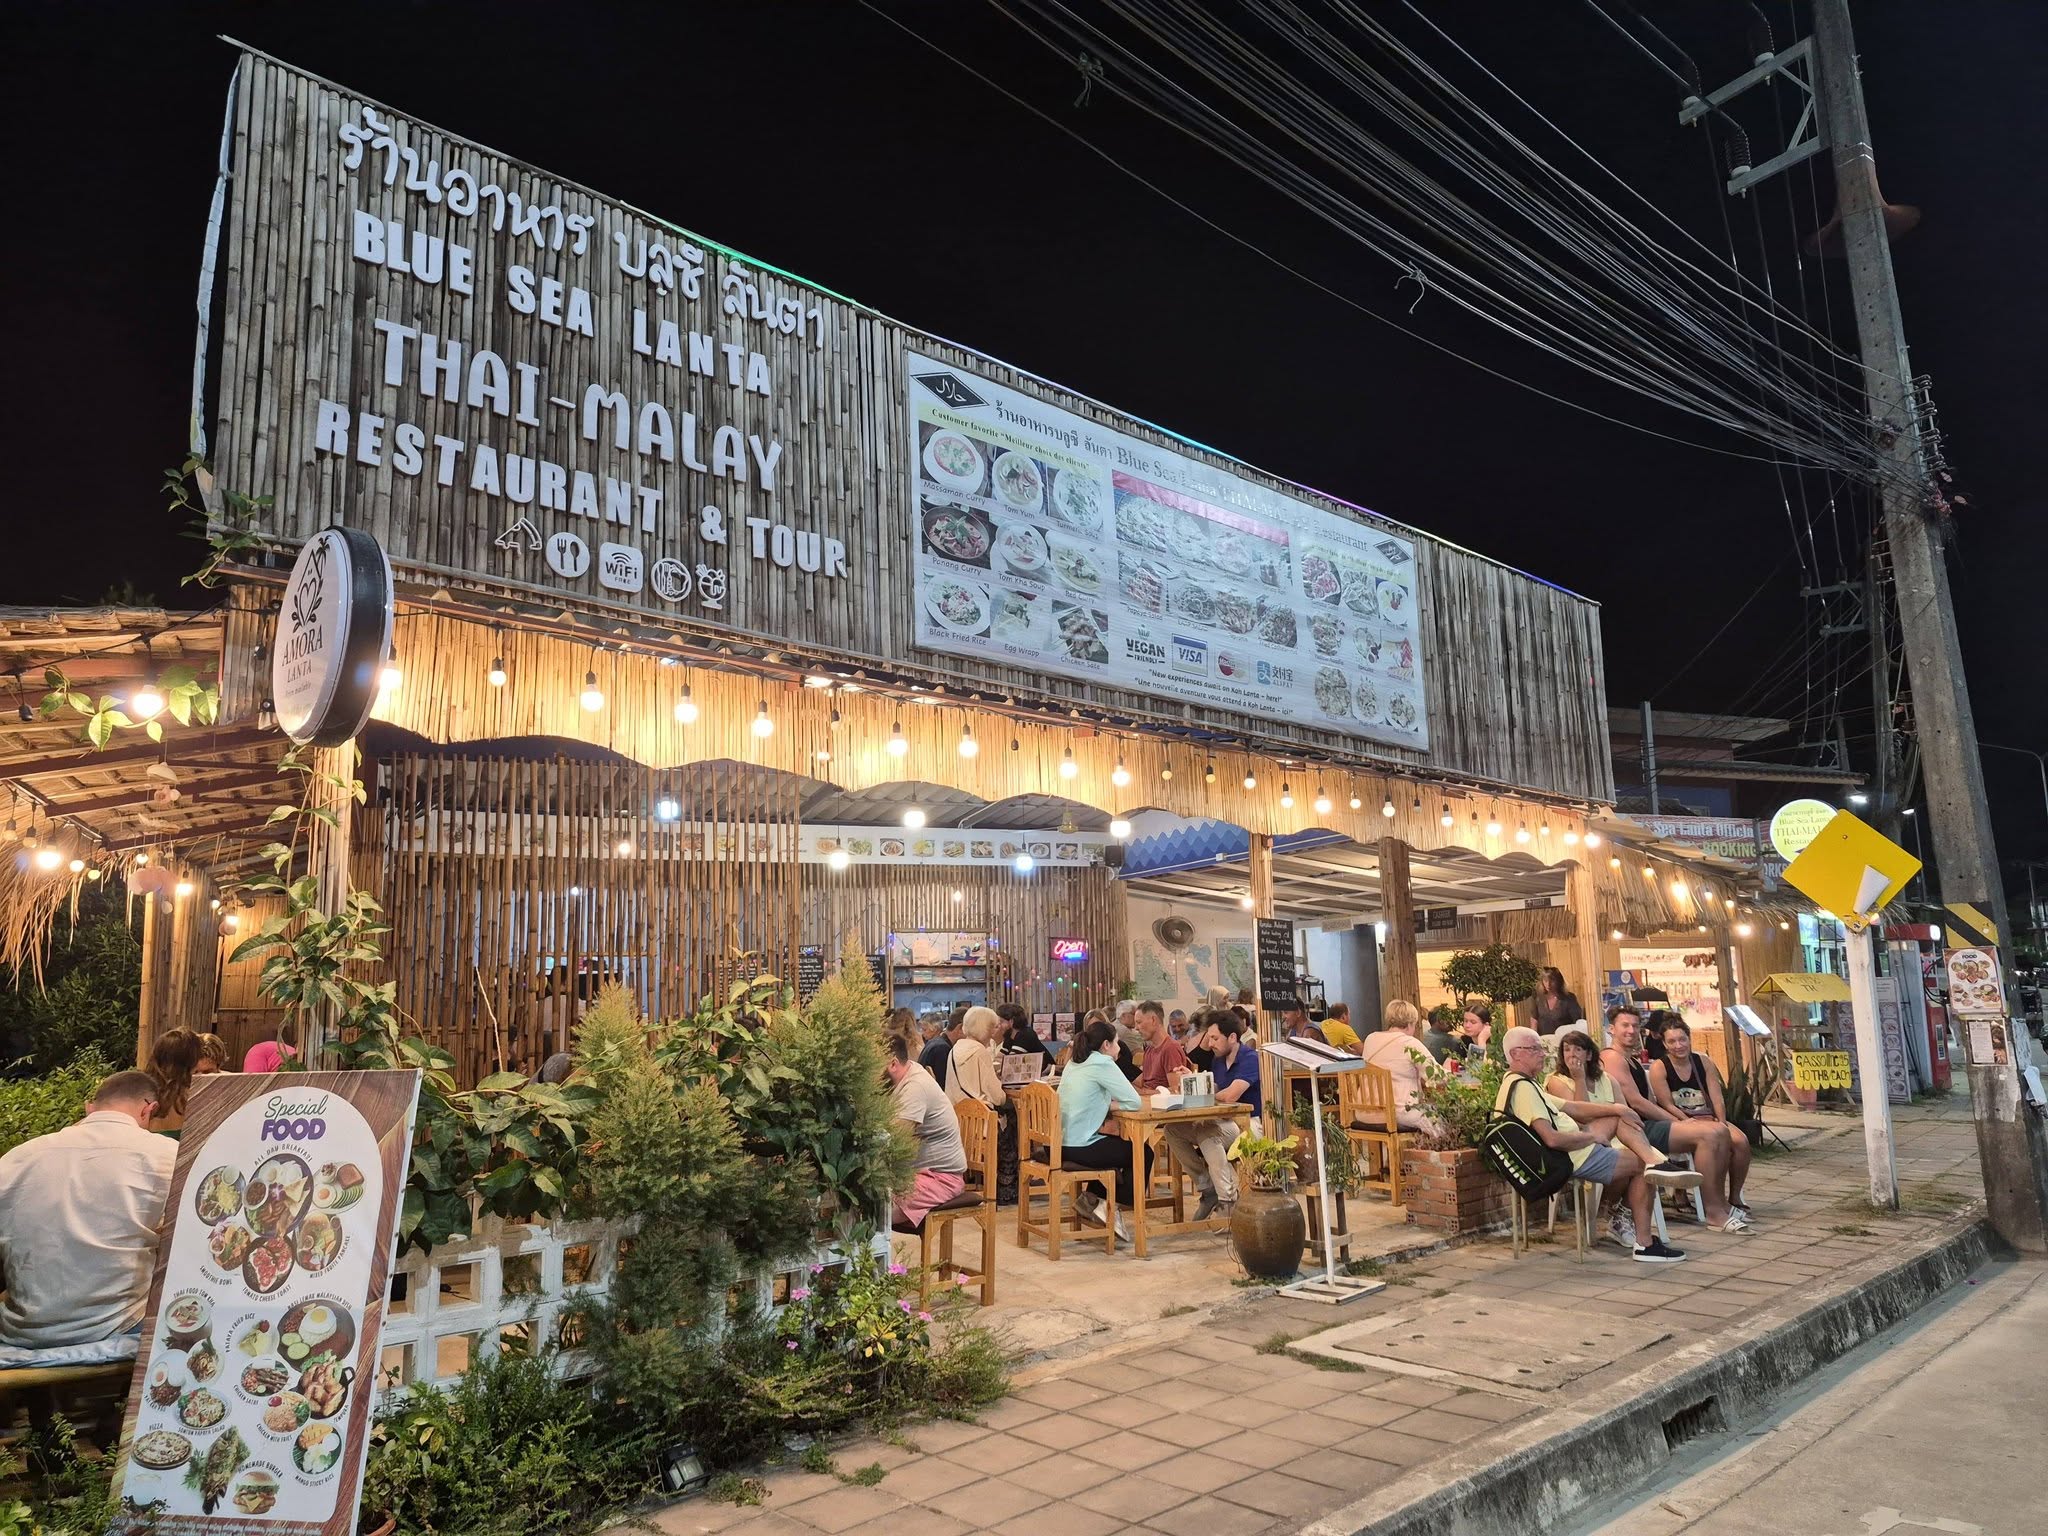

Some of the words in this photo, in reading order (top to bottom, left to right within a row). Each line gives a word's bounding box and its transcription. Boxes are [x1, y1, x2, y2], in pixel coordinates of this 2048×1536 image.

[339, 106, 595, 255] ร้านอาหาร
[724, 261, 824, 350] ลันตา
[354, 210, 474, 299] BLUE
[508, 265, 594, 339] SEA
[633, 308, 772, 397] LANTA
[375, 318, 783, 492] THAI-MALAY
[932, 408, 969, 428] Customer
[971, 421, 998, 439] favorite
[1118, 446, 1149, 473] Blue
[315, 400, 664, 533] RESTAURANT
[699, 505, 728, 546] &
[747, 516, 849, 579] TOUR
[923, 481, 964, 498] Massaman
[966, 493, 986, 505] Curry
[1004, 504, 1019, 514] Tom
[1021, 508, 1035, 519] Yum
[606, 561, 638, 579] WiFi
[932, 557, 959, 571] Panang
[961, 564, 981, 576] Curry
[999, 573, 1013, 583] Tom
[282, 625, 322, 666] AMORA
[929, 628, 950, 639] Black
[952, 633, 970, 643] Fried
[971, 637, 987, 646] Rice
[1126, 638, 1165, 658] VEGAN
[1004, 643, 1017, 655] Egg
[1018, 645, 1040, 658] Wrapp
[1179, 647, 1202, 664] VISA
[288, 659, 312, 683] LANTA
[1168, 674, 1202, 687] experiences
[1243, 690, 1260, 699] Lanta
[1180, 688, 1206, 698] aventure
[1248, 701, 1259, 709] Koh
[1260, 704, 1276, 712] Lanta
[1703, 841, 1757, 858] BOOKING
[1054, 940, 1084, 956] Open
[265, 1095, 328, 1120] Special
[261, 1118, 326, 1141] FOOD
[254, 1155, 264, 1166] ALL
[282, 1143, 312, 1162] BREAKFAST
[200, 1265, 219, 1285] SMOOTHIE
[219, 1277, 232, 1286] BOWL
[242, 1286, 258, 1301] TOMATO
[259, 1293, 276, 1303] CHEESE
[149, 1423, 163, 1431] PIZZA
